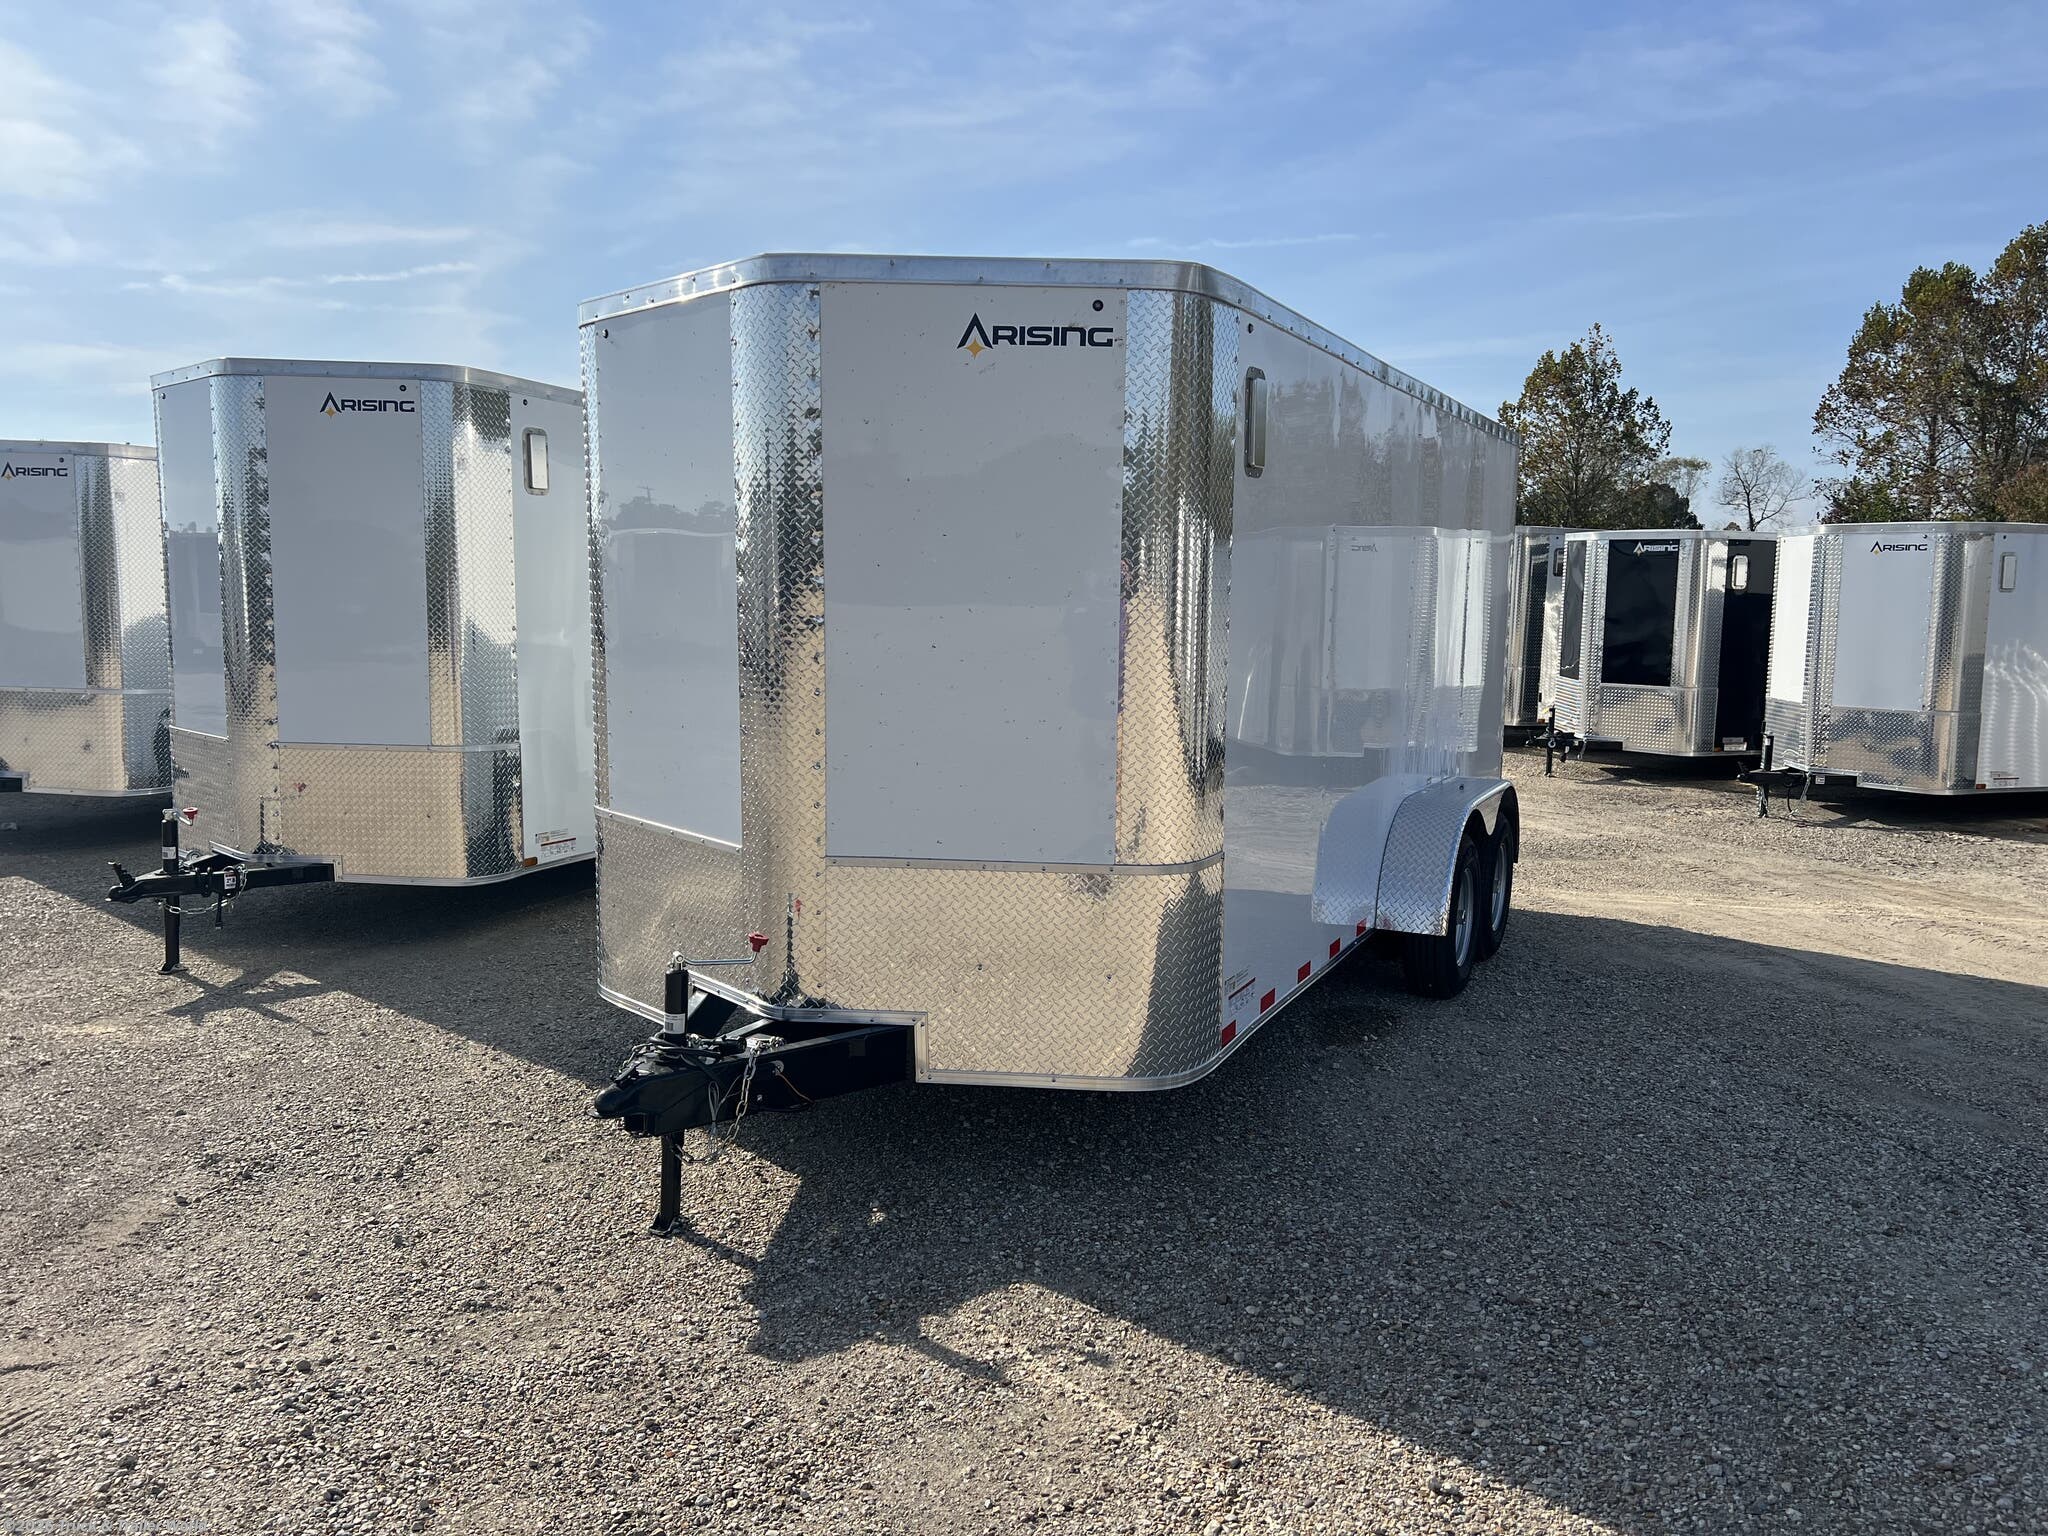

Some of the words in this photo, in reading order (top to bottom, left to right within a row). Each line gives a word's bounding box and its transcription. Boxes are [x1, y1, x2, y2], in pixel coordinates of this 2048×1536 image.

[957, 312, 1114, 349] ARISING
[319, 391, 415, 414] ARISING
[1, 461, 68, 478] ARISING
[1870, 541, 1928, 553] ARISING
